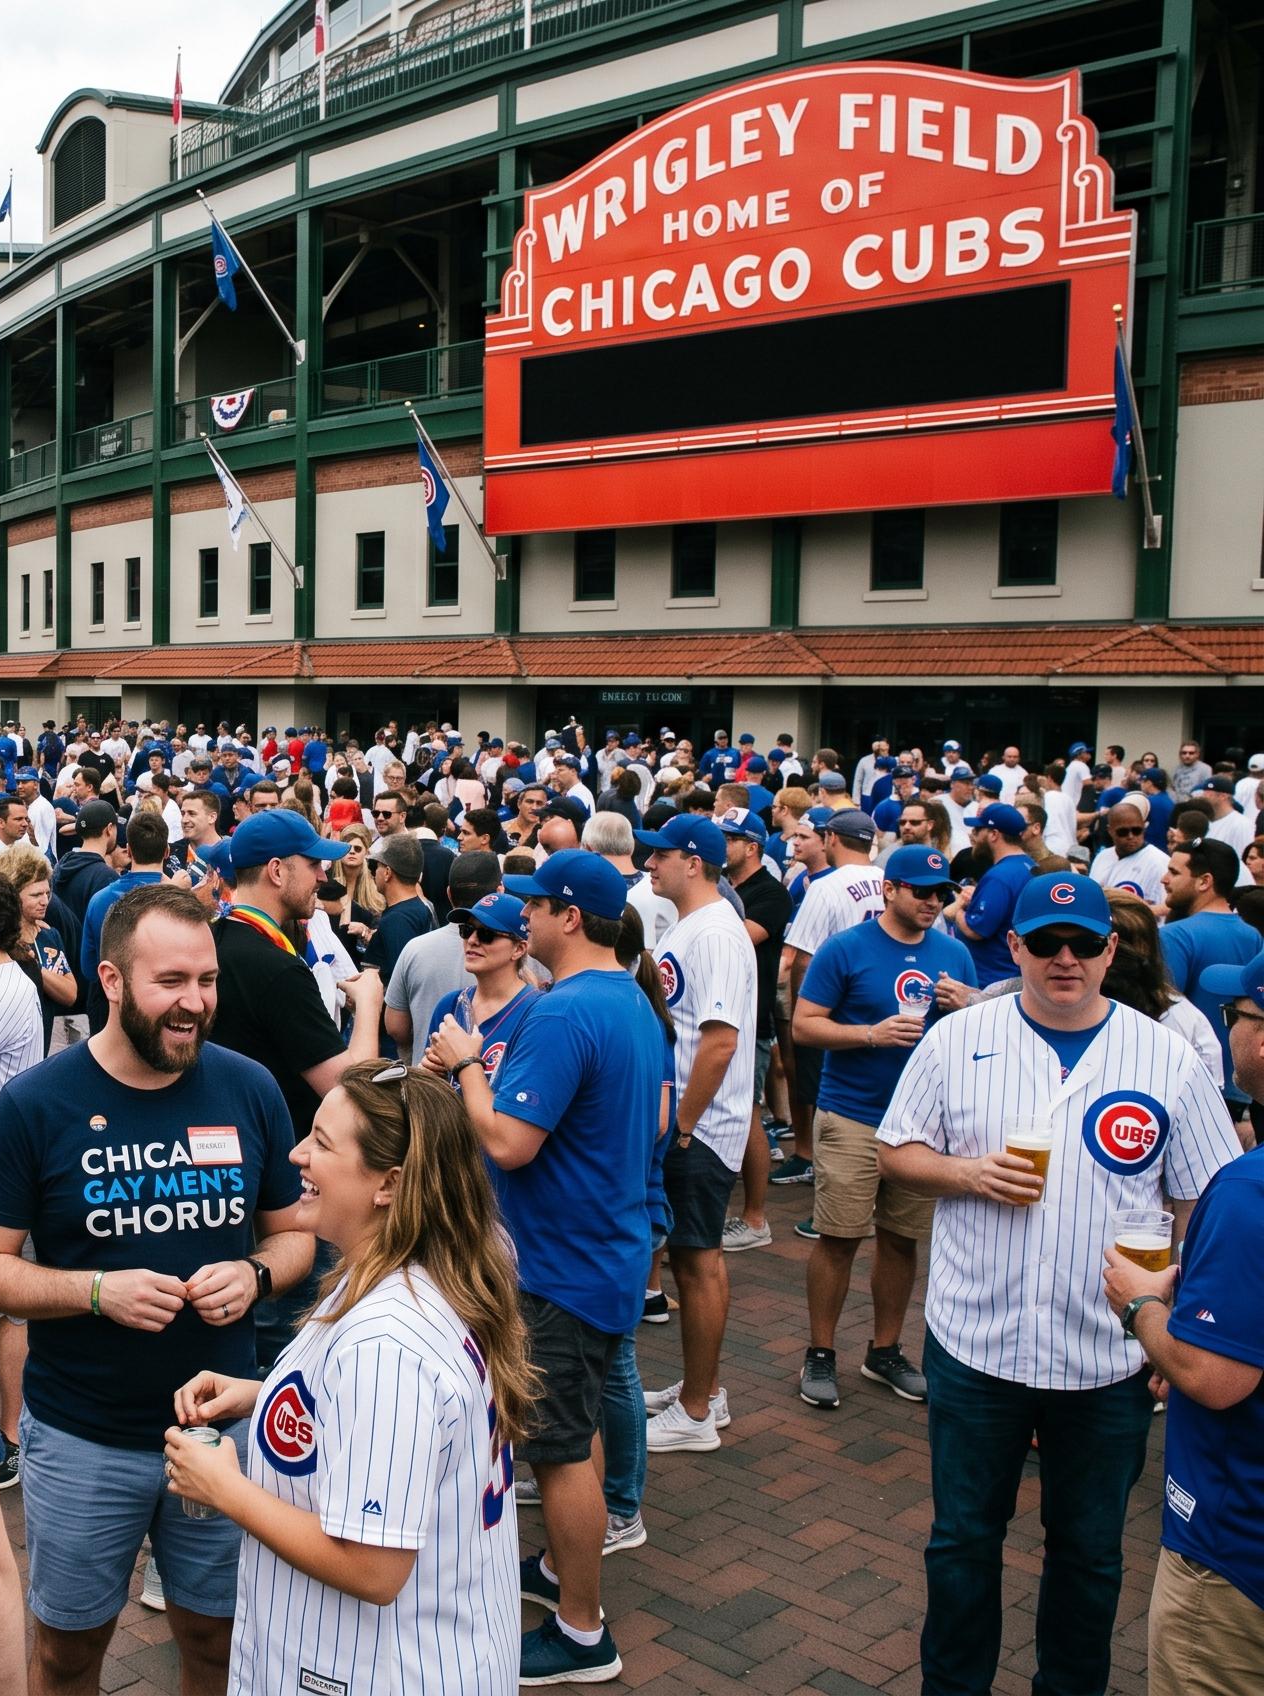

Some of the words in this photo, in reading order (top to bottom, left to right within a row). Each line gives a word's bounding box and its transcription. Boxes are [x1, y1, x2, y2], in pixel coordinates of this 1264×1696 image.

[541, 98, 811, 263] WRIGLEY
[838, 92, 1044, 176] FIELD
[661, 187, 791, 246] HOME
[820, 171, 885, 214] OF
[540, 246, 812, 337] CHICAGO
[842, 206, 1045, 291] CUBS
[1050, 883, 1075, 904] C
[81, 1140, 193, 1175] CHICA
[1098, 1105, 1157, 1162] CUBS
[83, 1176, 146, 1205] GAY
[154, 1167, 245, 1198] MEN'S
[85, 1196, 245, 1238] CHORUS
[265, 1386, 315, 1458] CUBS
